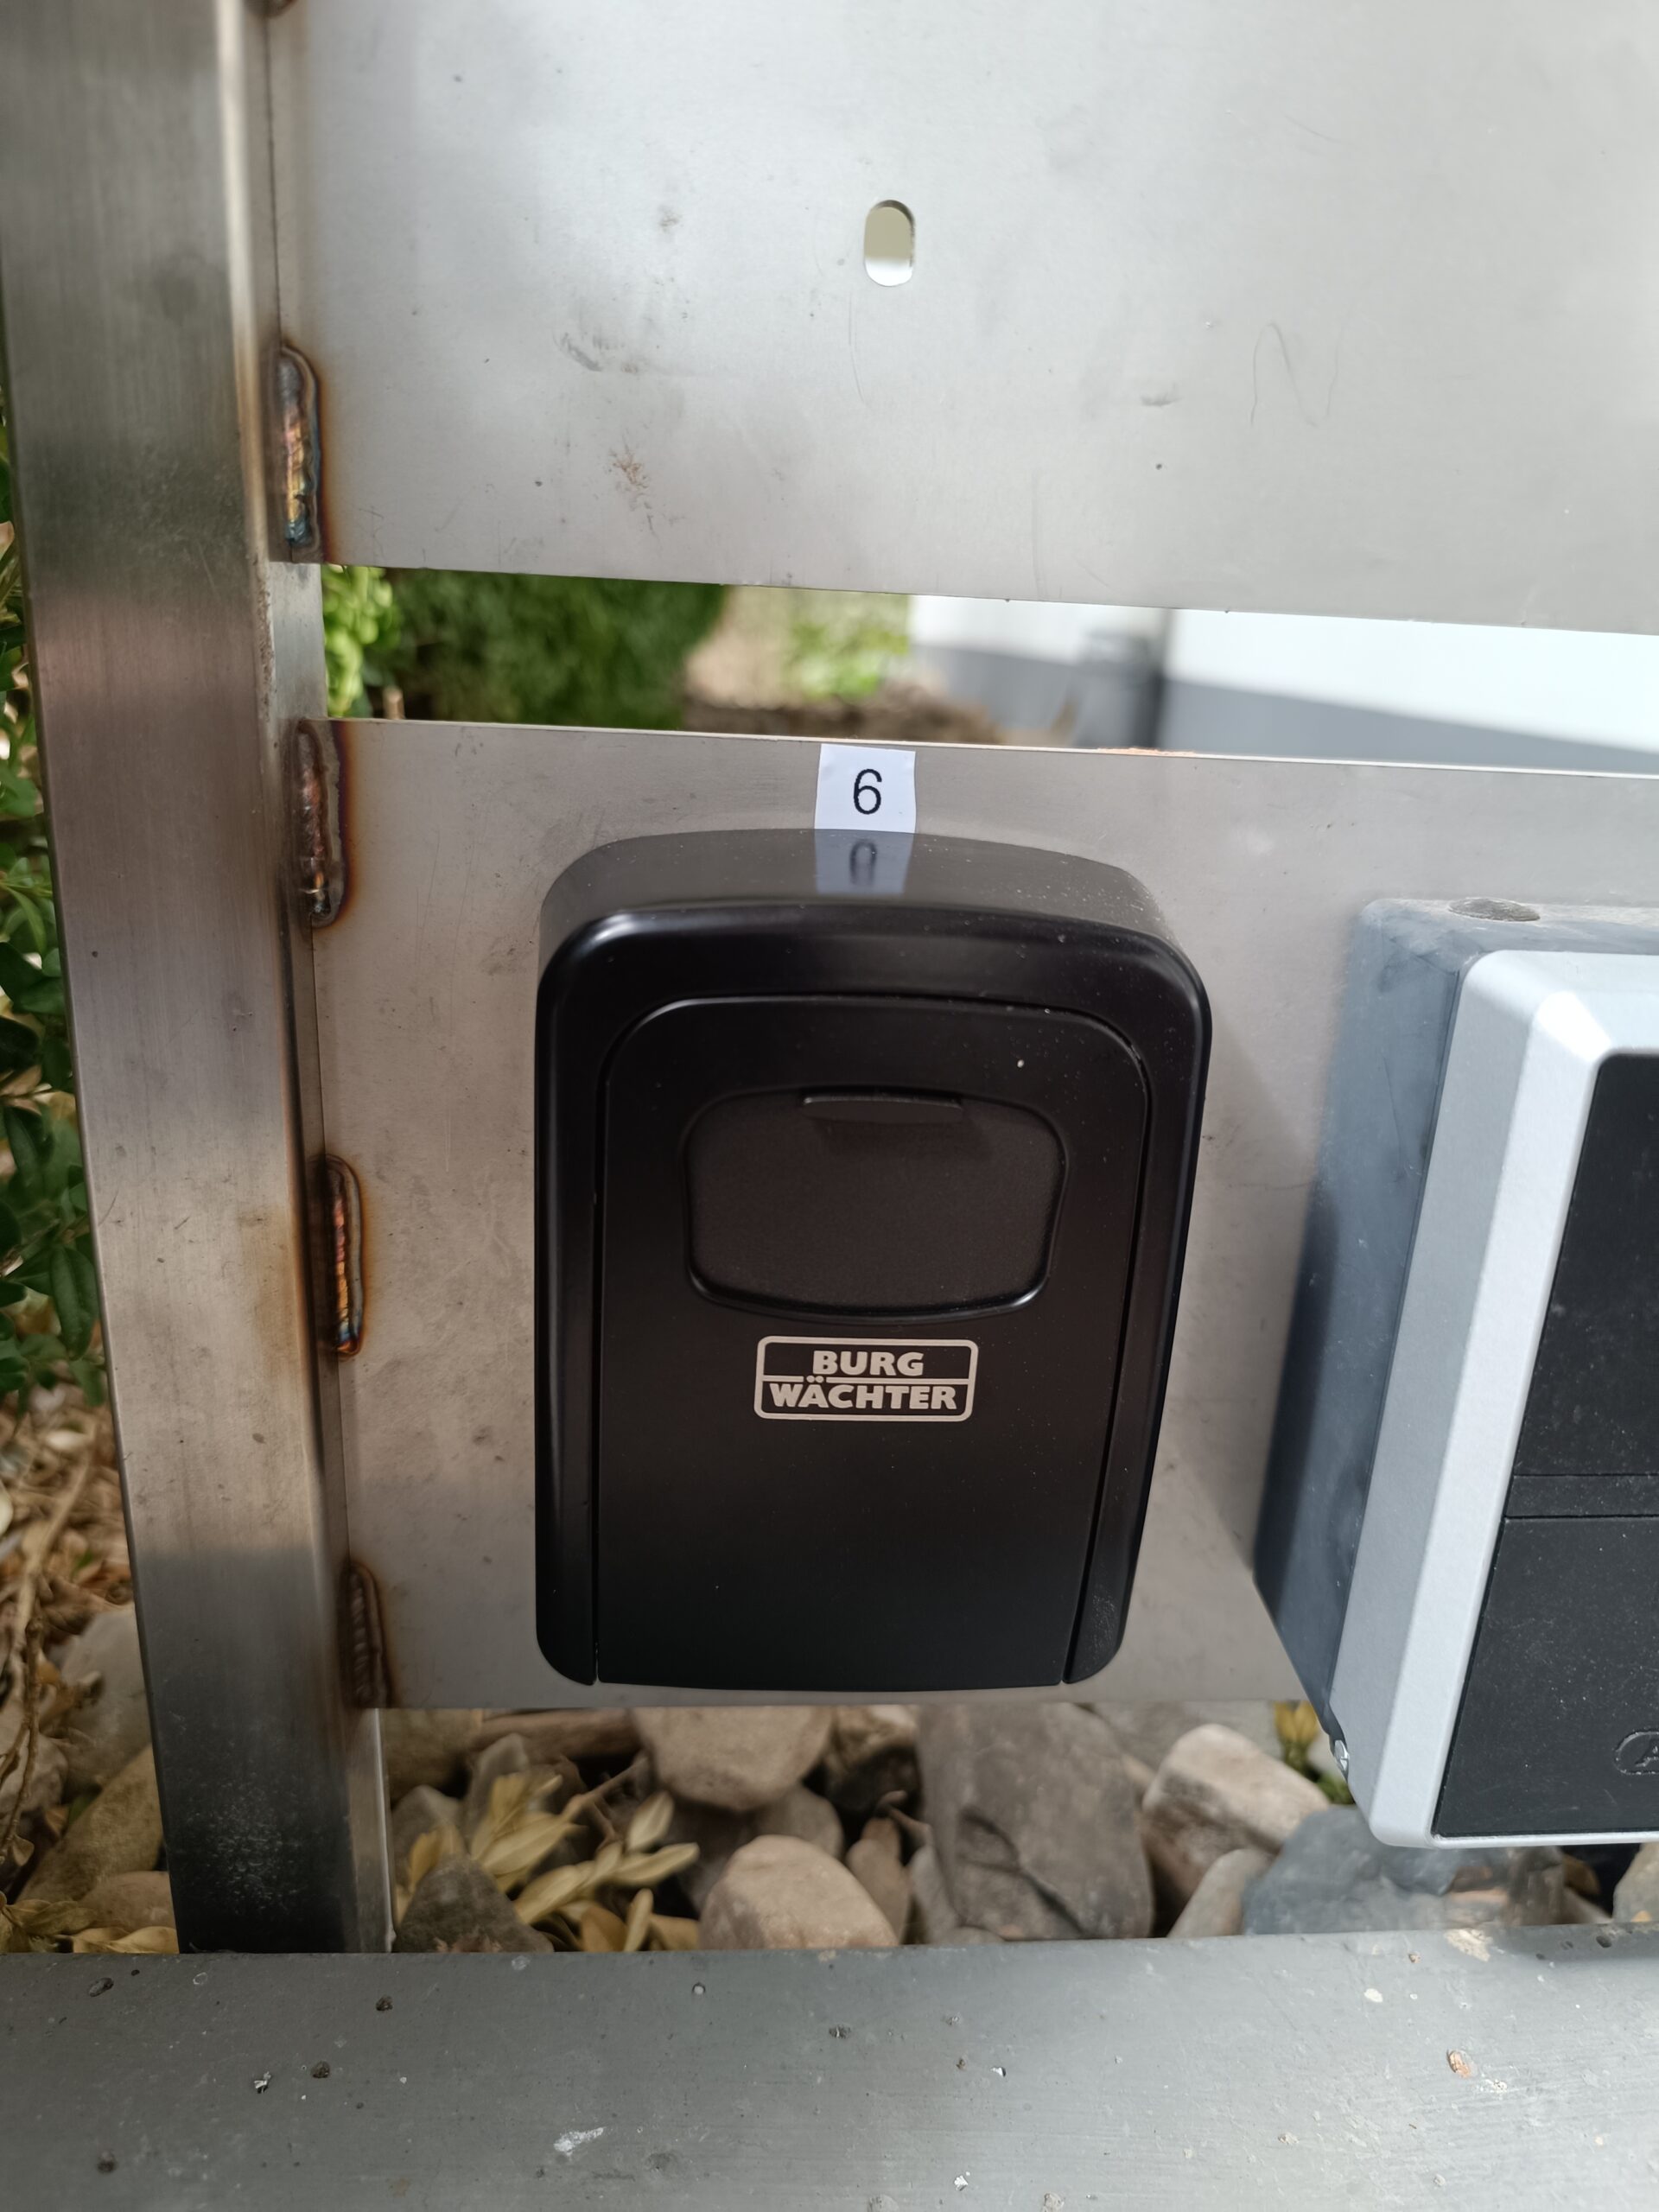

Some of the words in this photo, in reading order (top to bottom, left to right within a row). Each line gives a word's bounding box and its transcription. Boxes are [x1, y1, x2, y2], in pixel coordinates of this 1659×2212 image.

[853, 768, 882, 815] 6
[812, 1350, 925, 1376] BURG
[769, 1375, 957, 1410] WÄCHTER
